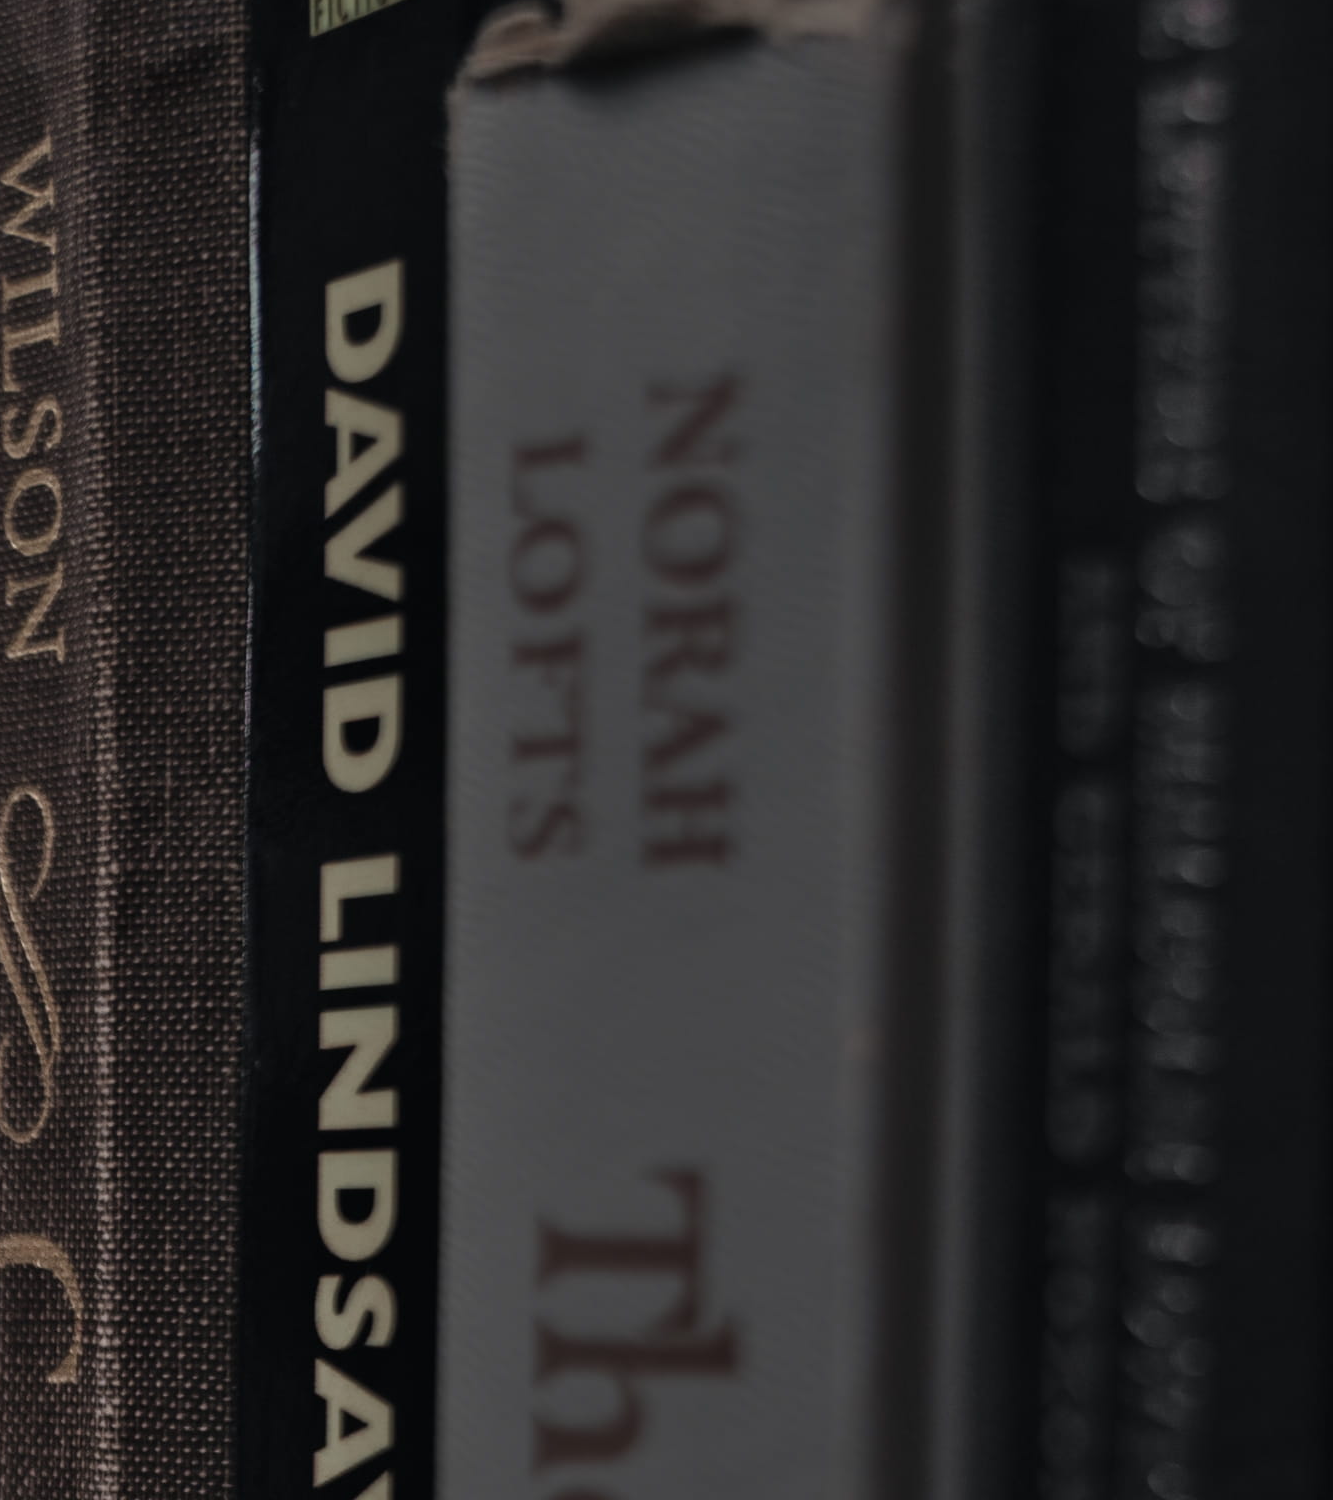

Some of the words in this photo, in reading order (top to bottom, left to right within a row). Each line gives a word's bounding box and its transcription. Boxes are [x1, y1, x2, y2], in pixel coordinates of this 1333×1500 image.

[321, 256, 406, 796] DAVID
[504, 434, 593, 865] LOFTS
[638, 373, 742, 874] NORAH
